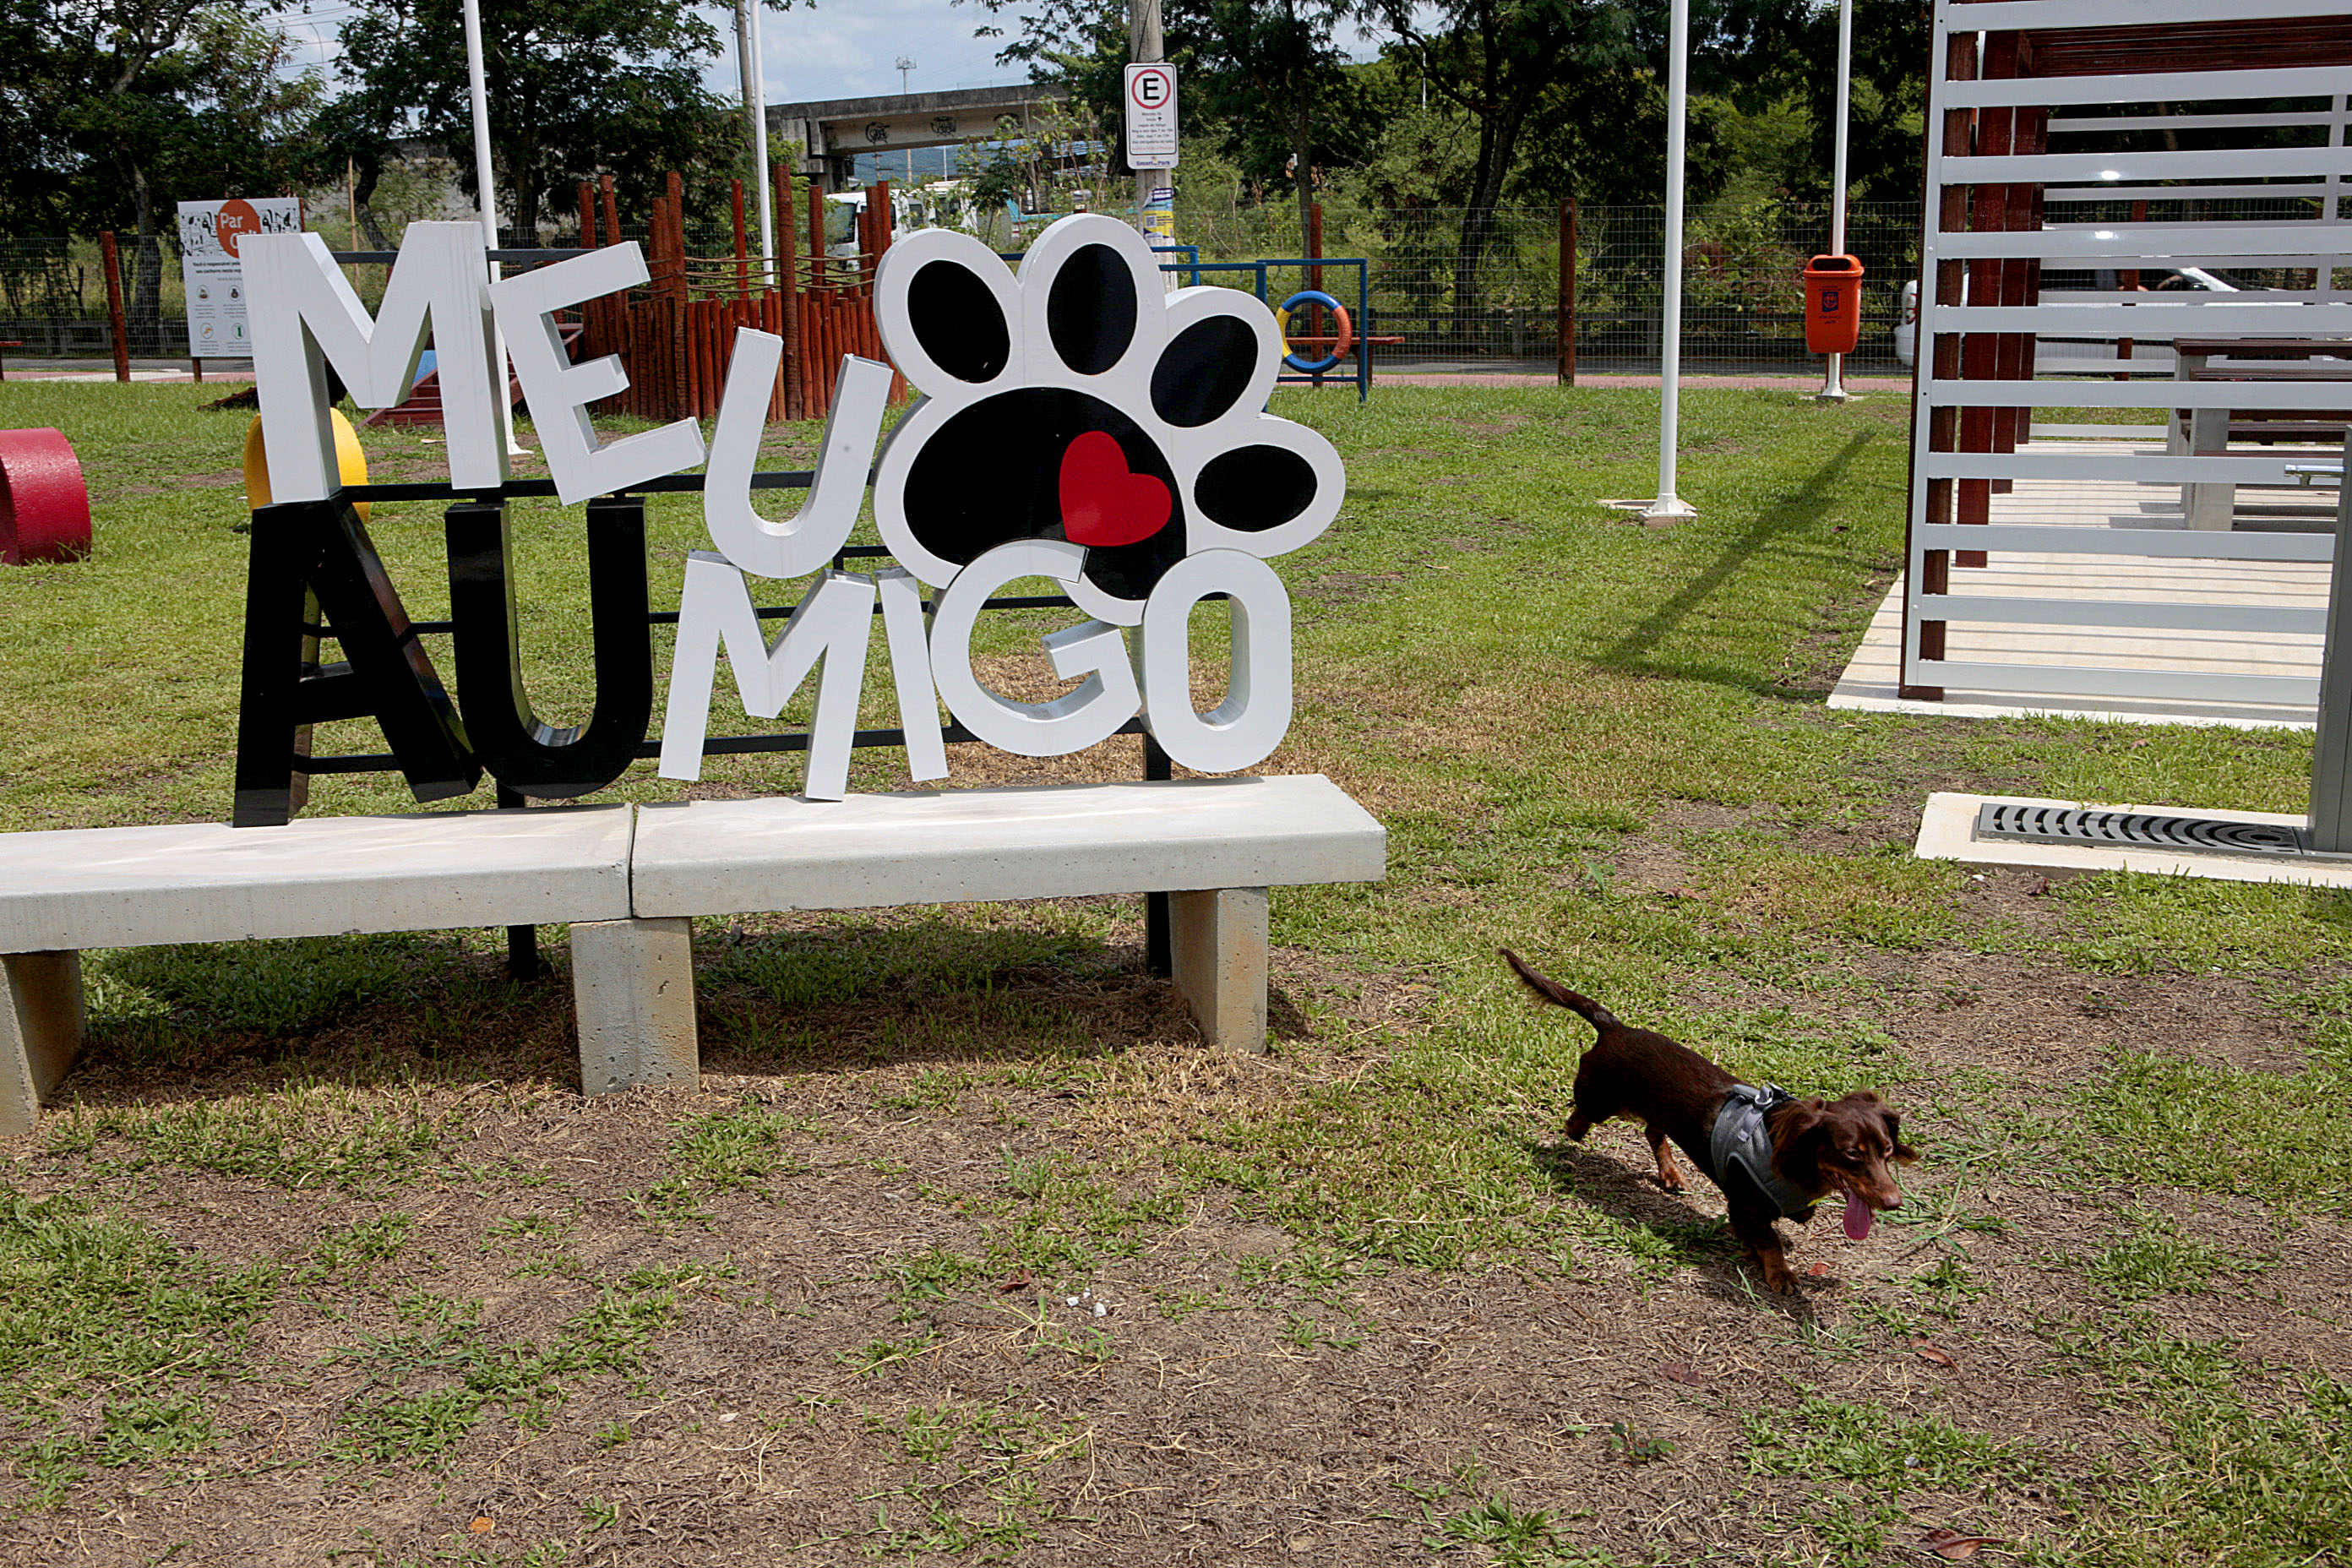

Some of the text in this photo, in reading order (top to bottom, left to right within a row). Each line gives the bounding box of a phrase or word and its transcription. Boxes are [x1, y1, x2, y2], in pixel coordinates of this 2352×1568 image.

[1143, 78, 1160, 100] E
[220, 212, 243, 229] Par
[240, 220, 894, 579] MEU
